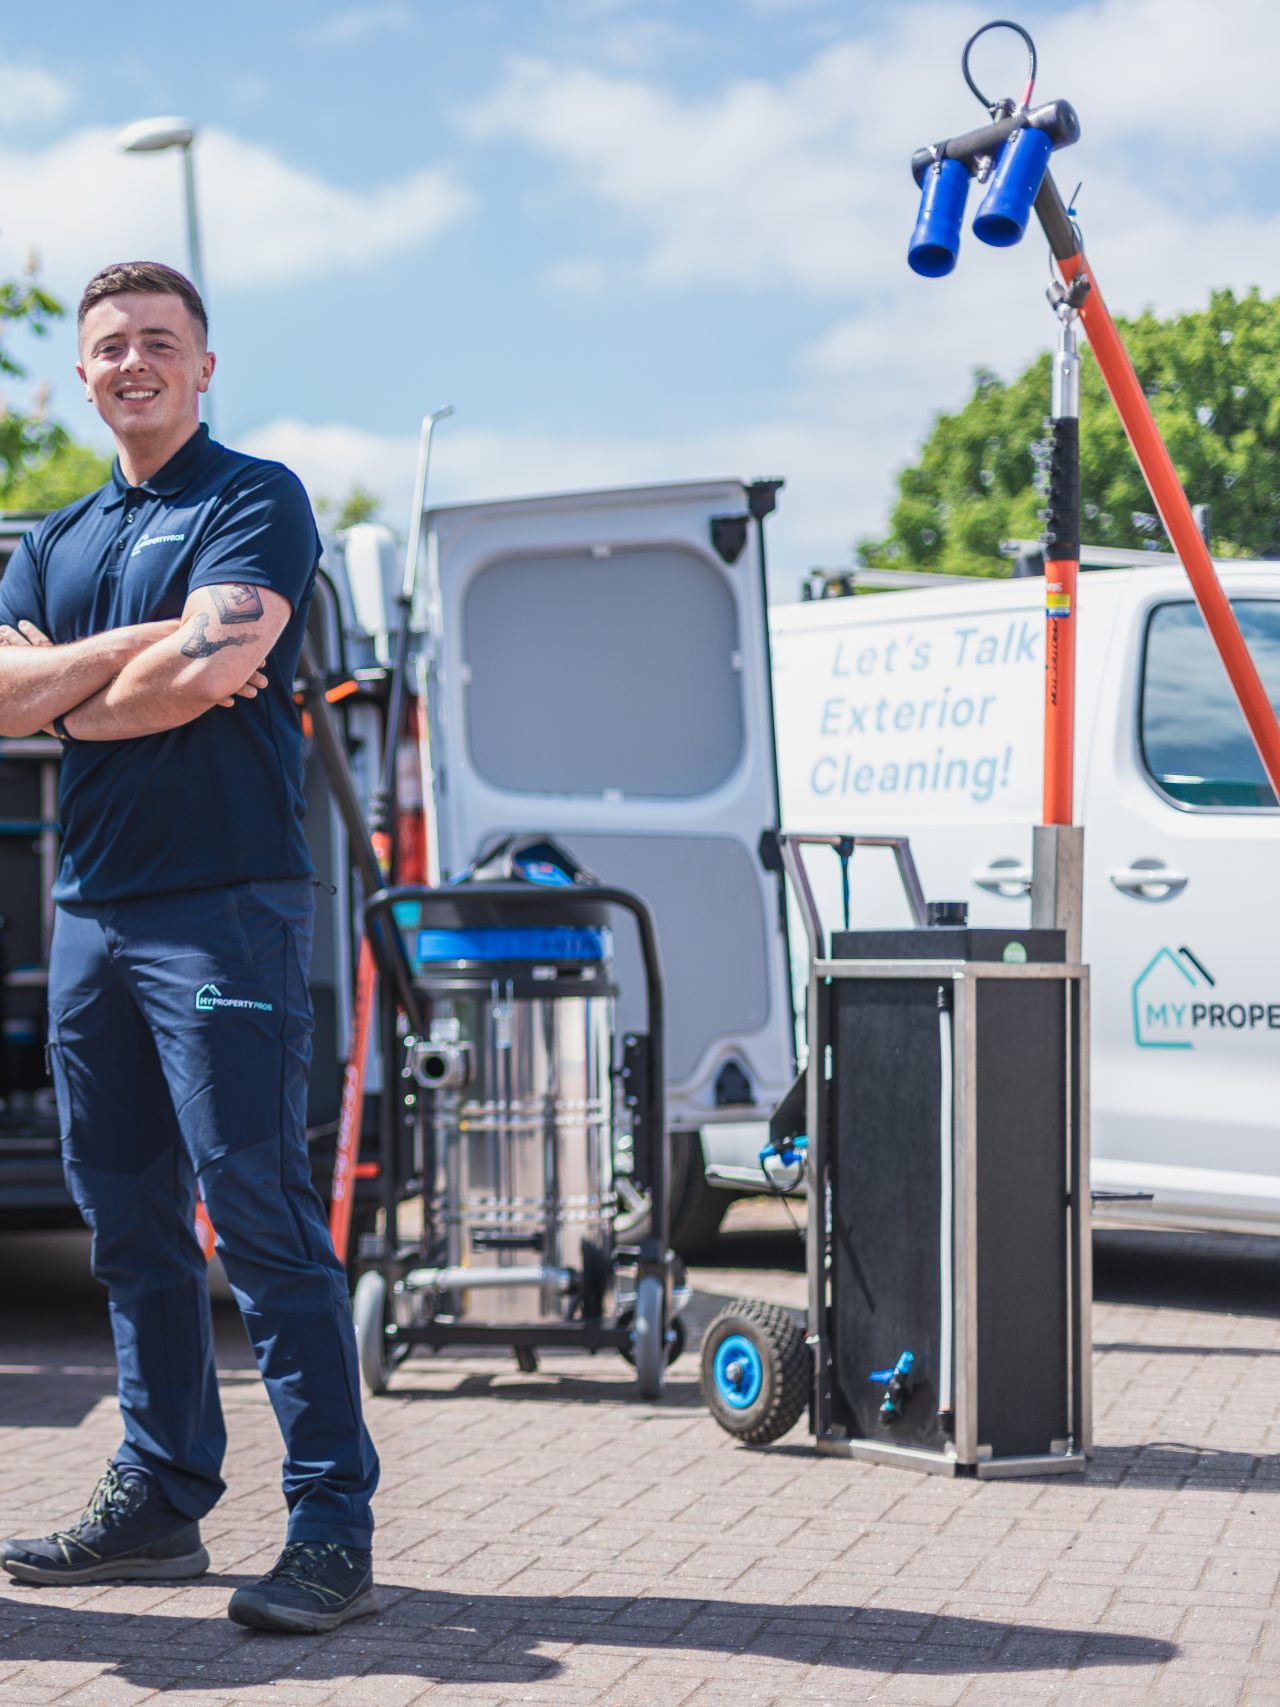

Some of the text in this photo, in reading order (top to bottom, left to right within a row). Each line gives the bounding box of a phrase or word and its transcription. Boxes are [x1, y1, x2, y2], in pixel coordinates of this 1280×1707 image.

[831, 633, 932, 677] Let's
[954, 621, 1041, 667] Talk
[819, 687, 996, 736] Exterior
[810, 745, 1013, 802] Cleaning!
